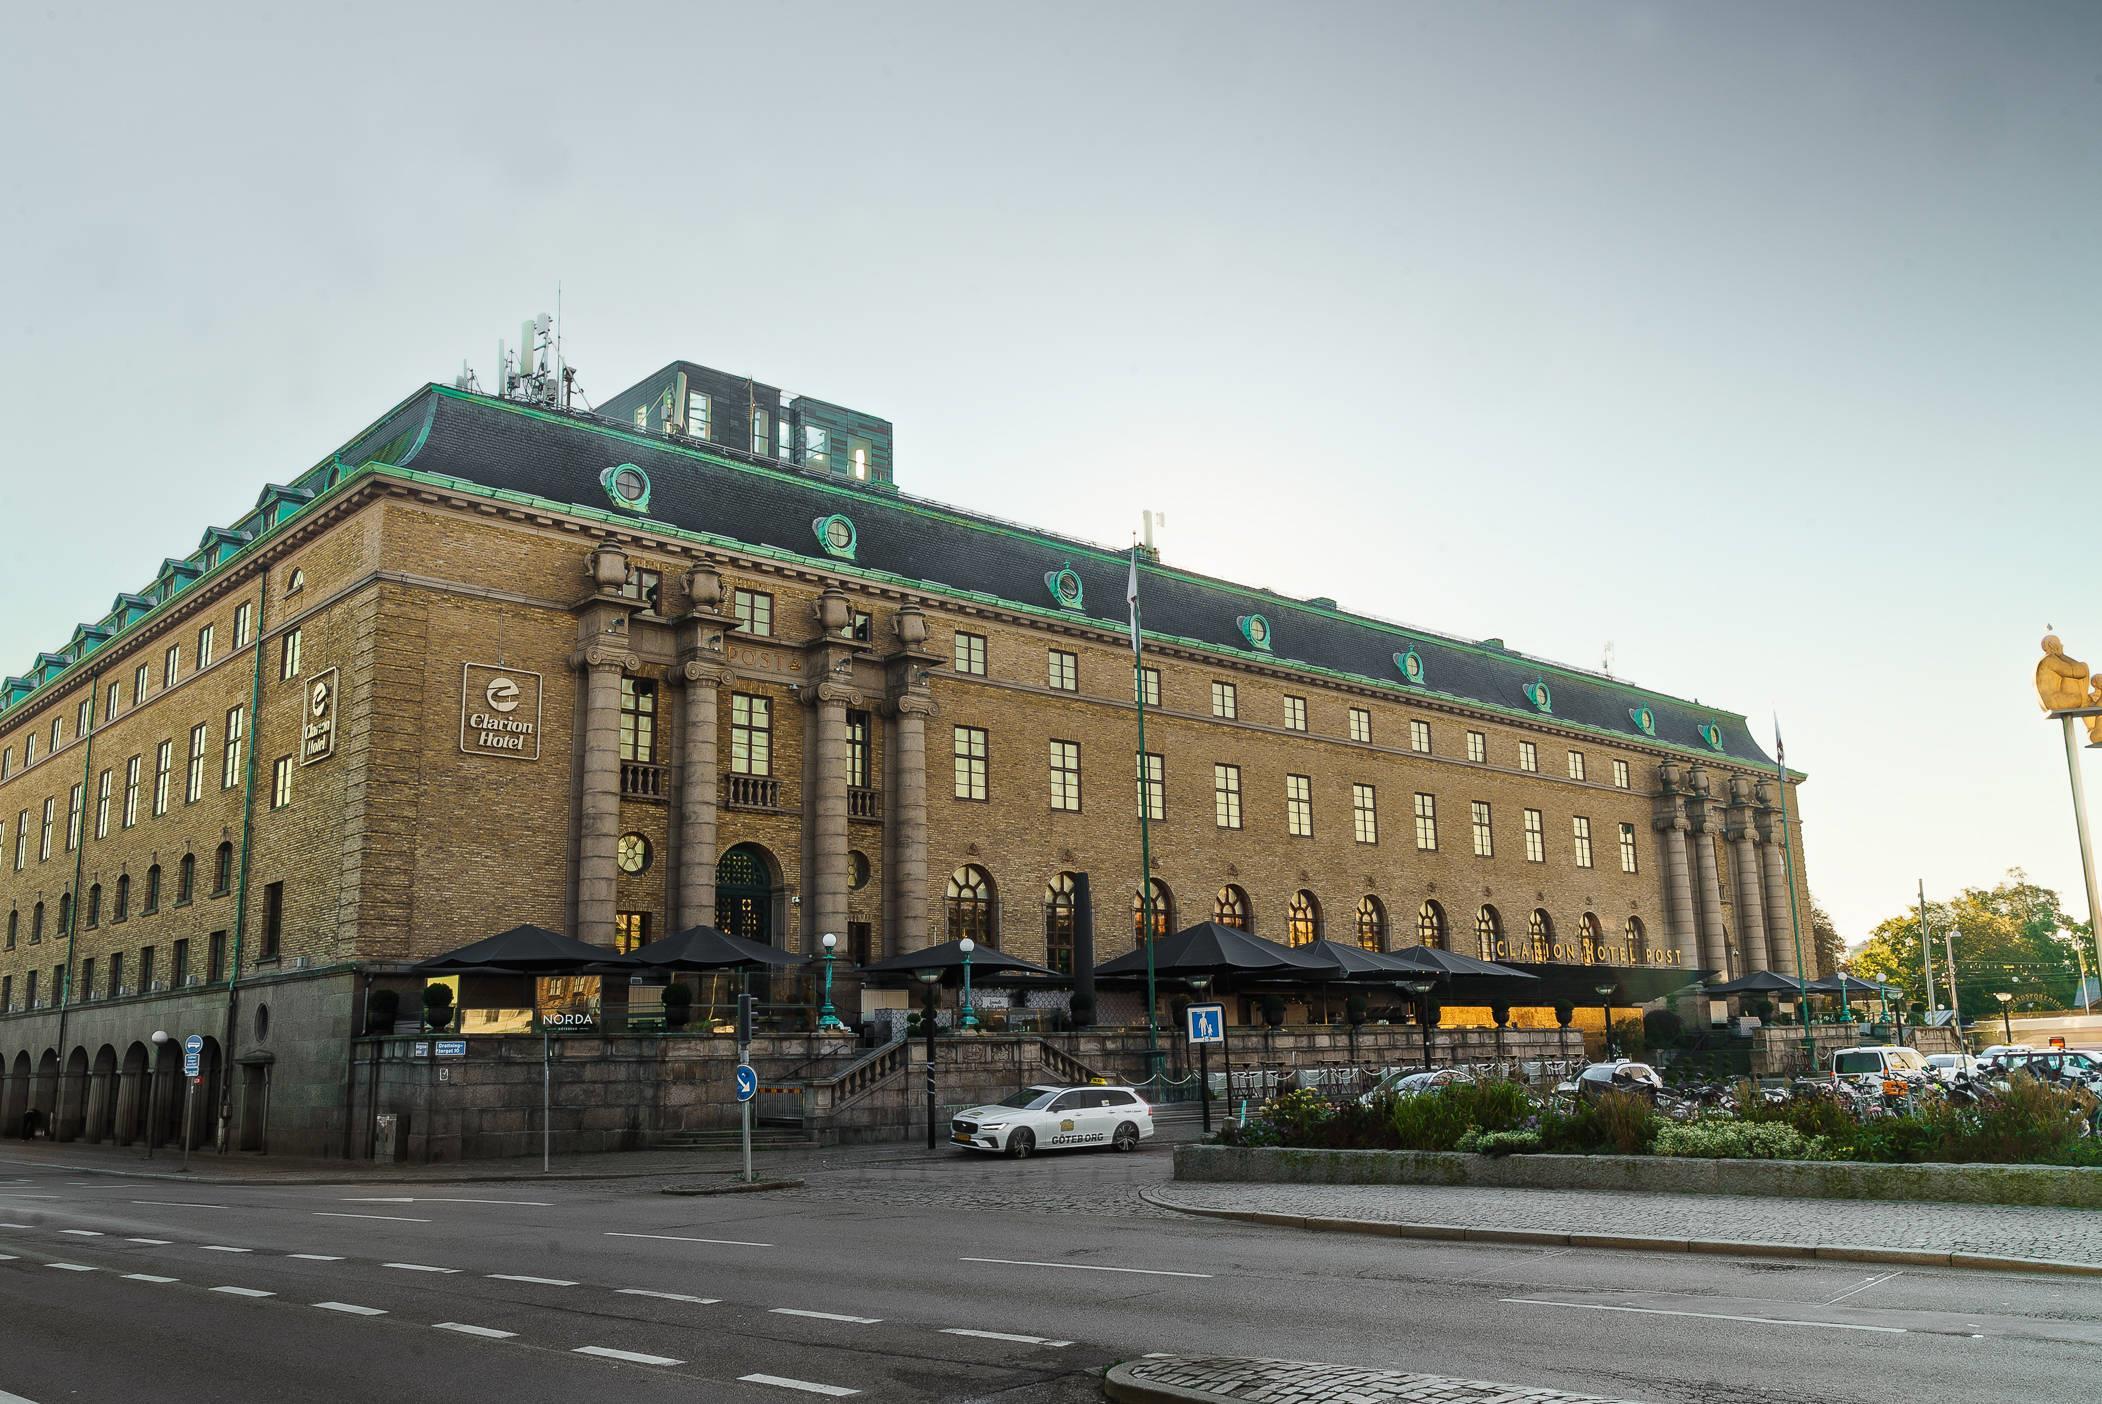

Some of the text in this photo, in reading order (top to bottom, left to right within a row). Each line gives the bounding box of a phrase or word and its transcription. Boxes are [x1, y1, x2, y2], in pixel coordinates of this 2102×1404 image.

[469, 713, 533, 734] Clarion
[478, 731, 524, 750] Hotel
[1496, 940, 1681, 965] CLARION HOTEL POST
[542, 1013, 593, 1025] NORDA
[1051, 1132, 1104, 1145] GÖTEBORG
